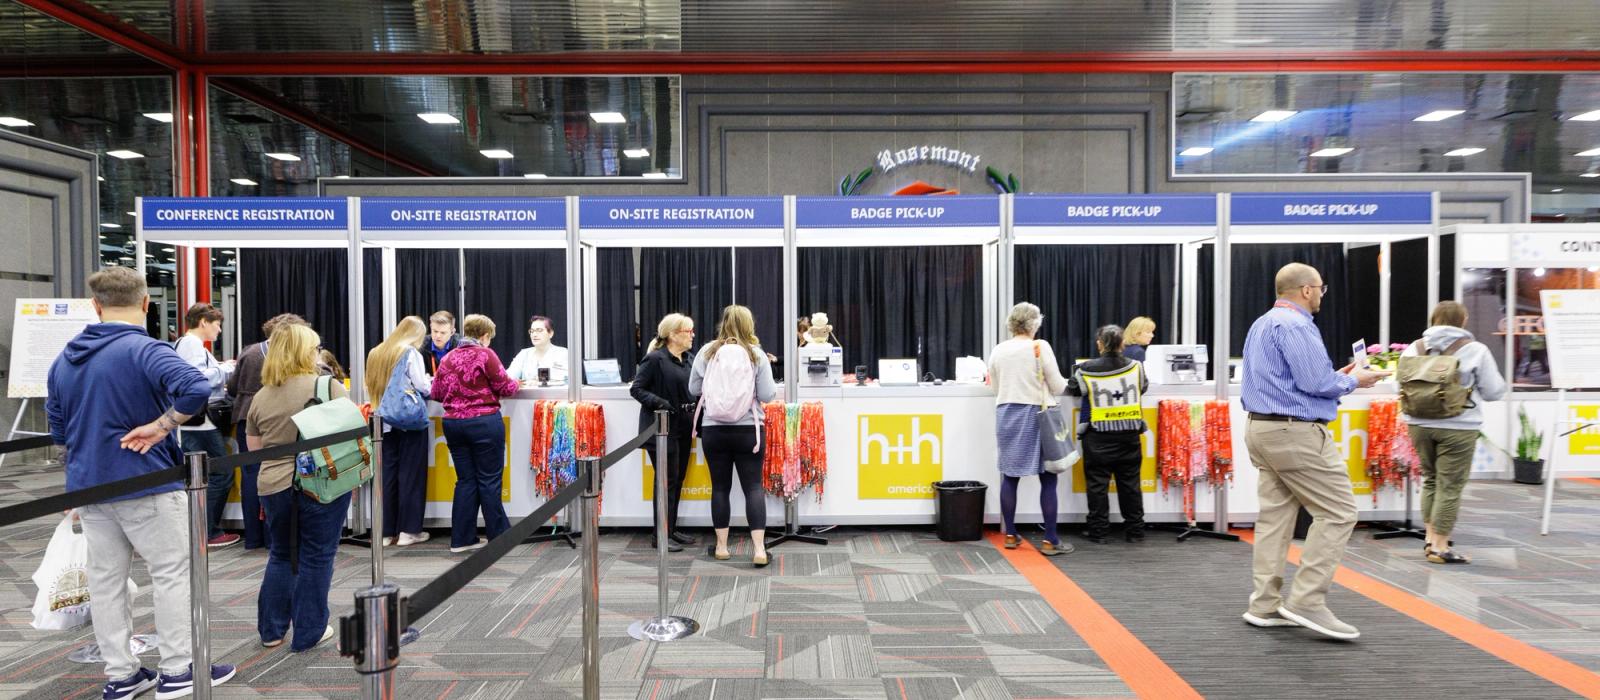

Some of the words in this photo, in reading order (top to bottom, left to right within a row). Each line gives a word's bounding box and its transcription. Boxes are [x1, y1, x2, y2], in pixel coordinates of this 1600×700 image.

[877, 145, 981, 173] Rosemont
[156, 209, 239, 221] CONFERENCE
[242, 209, 335, 221] REGISTRATION
[390, 209, 442, 221] ON-SITE
[445, 209, 537, 221] REGISTRATION
[609, 208, 660, 220] ON-SITE
[663, 208, 754, 220] REGISTRATION
[851, 207, 893, 219] BADGE
[895, 207, 945, 218] PICK-UP
[1067, 205, 1109, 217] BADGE
[1112, 205, 1162, 217] PICK-UP
[1283, 204, 1326, 216] BADGE
[1327, 204, 1378, 216] PICK-UP
[1092, 377, 1138, 407] h+h
[861, 416, 940, 465] h+h
[681, 485, 712, 495] meric
[887, 483, 934, 494] america
